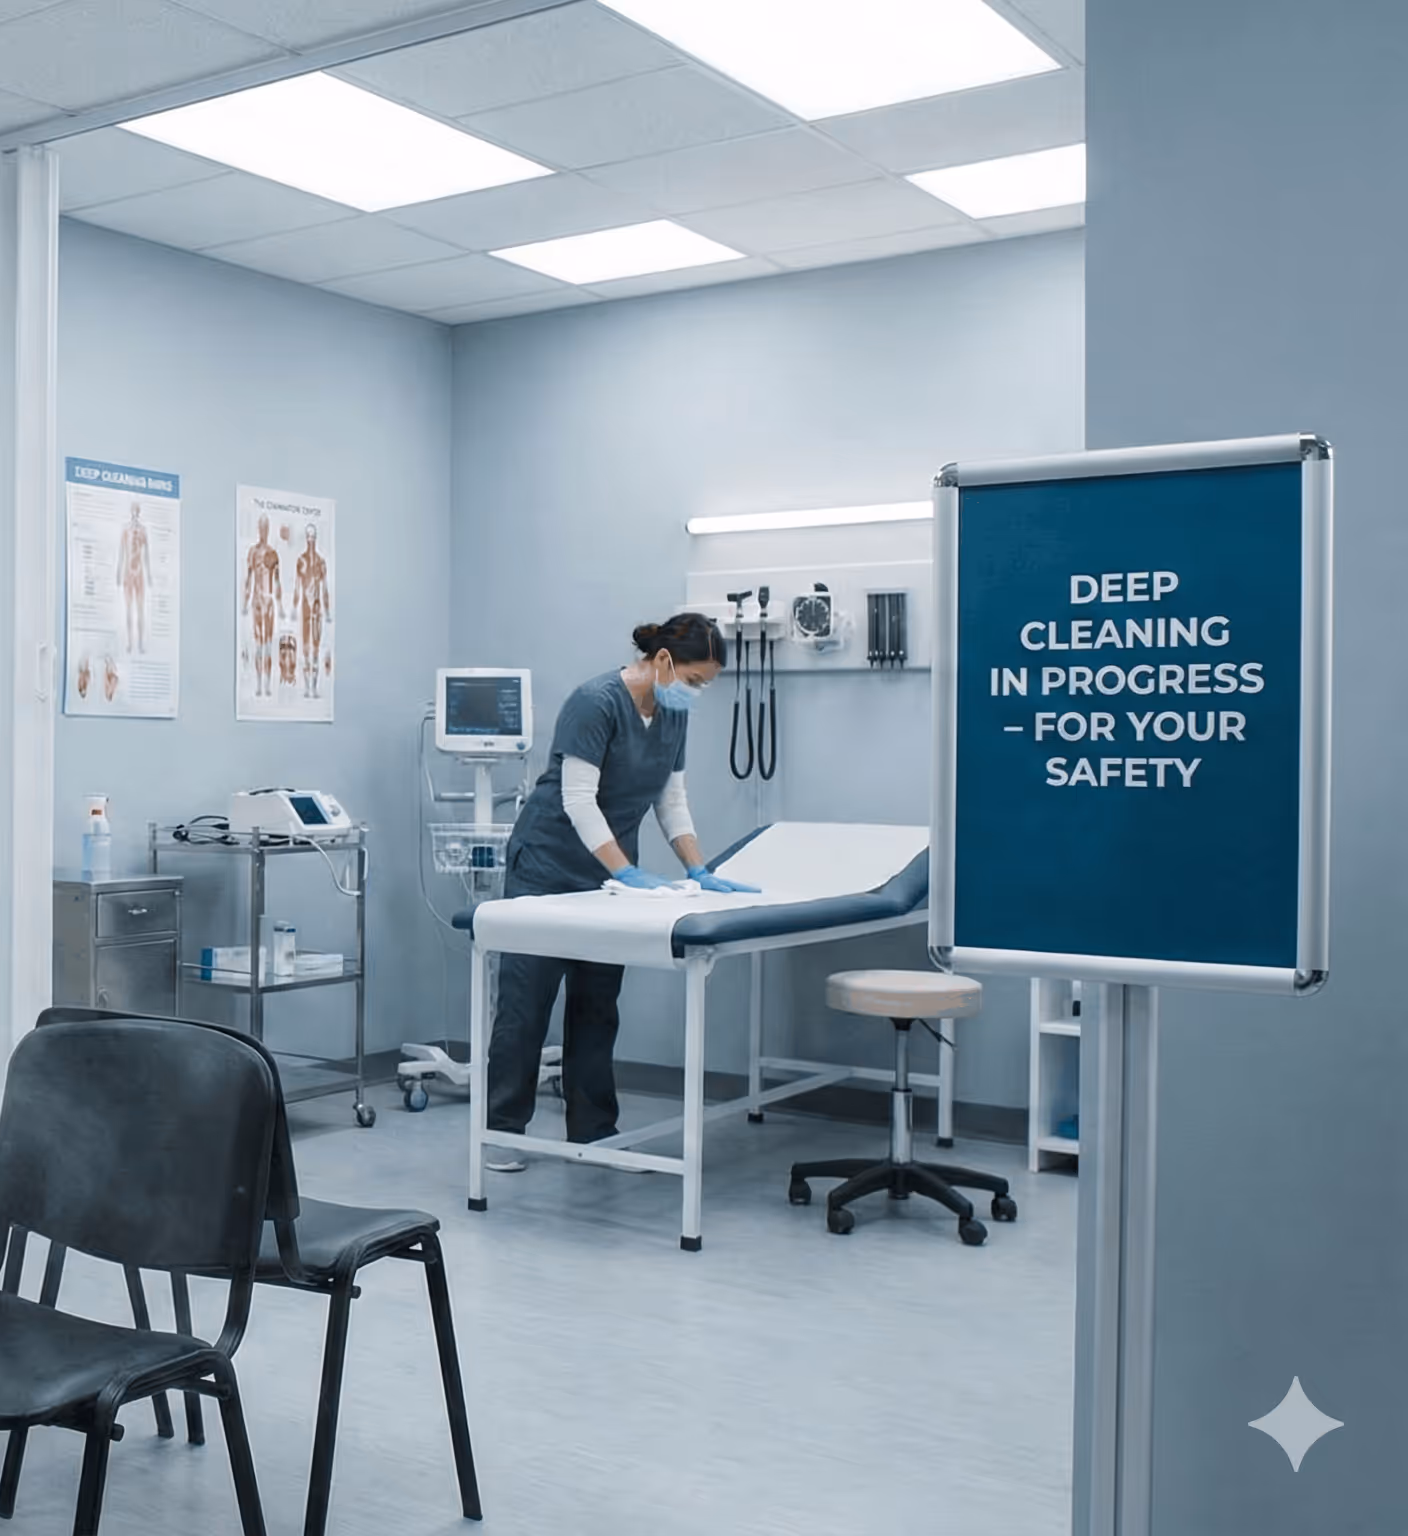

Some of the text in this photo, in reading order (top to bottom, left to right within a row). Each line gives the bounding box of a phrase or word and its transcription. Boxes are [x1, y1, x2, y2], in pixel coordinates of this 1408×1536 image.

[1070, 571, 1179, 604] DEEP
[1020, 615, 1230, 651] CLEANING
[990, 662, 1265, 696] IN PROGRESS
[1035, 711, 1115, 742] FOR
[1126, 711, 1246, 742] YOUR
[1046, 757, 1202, 788] SAFETY
